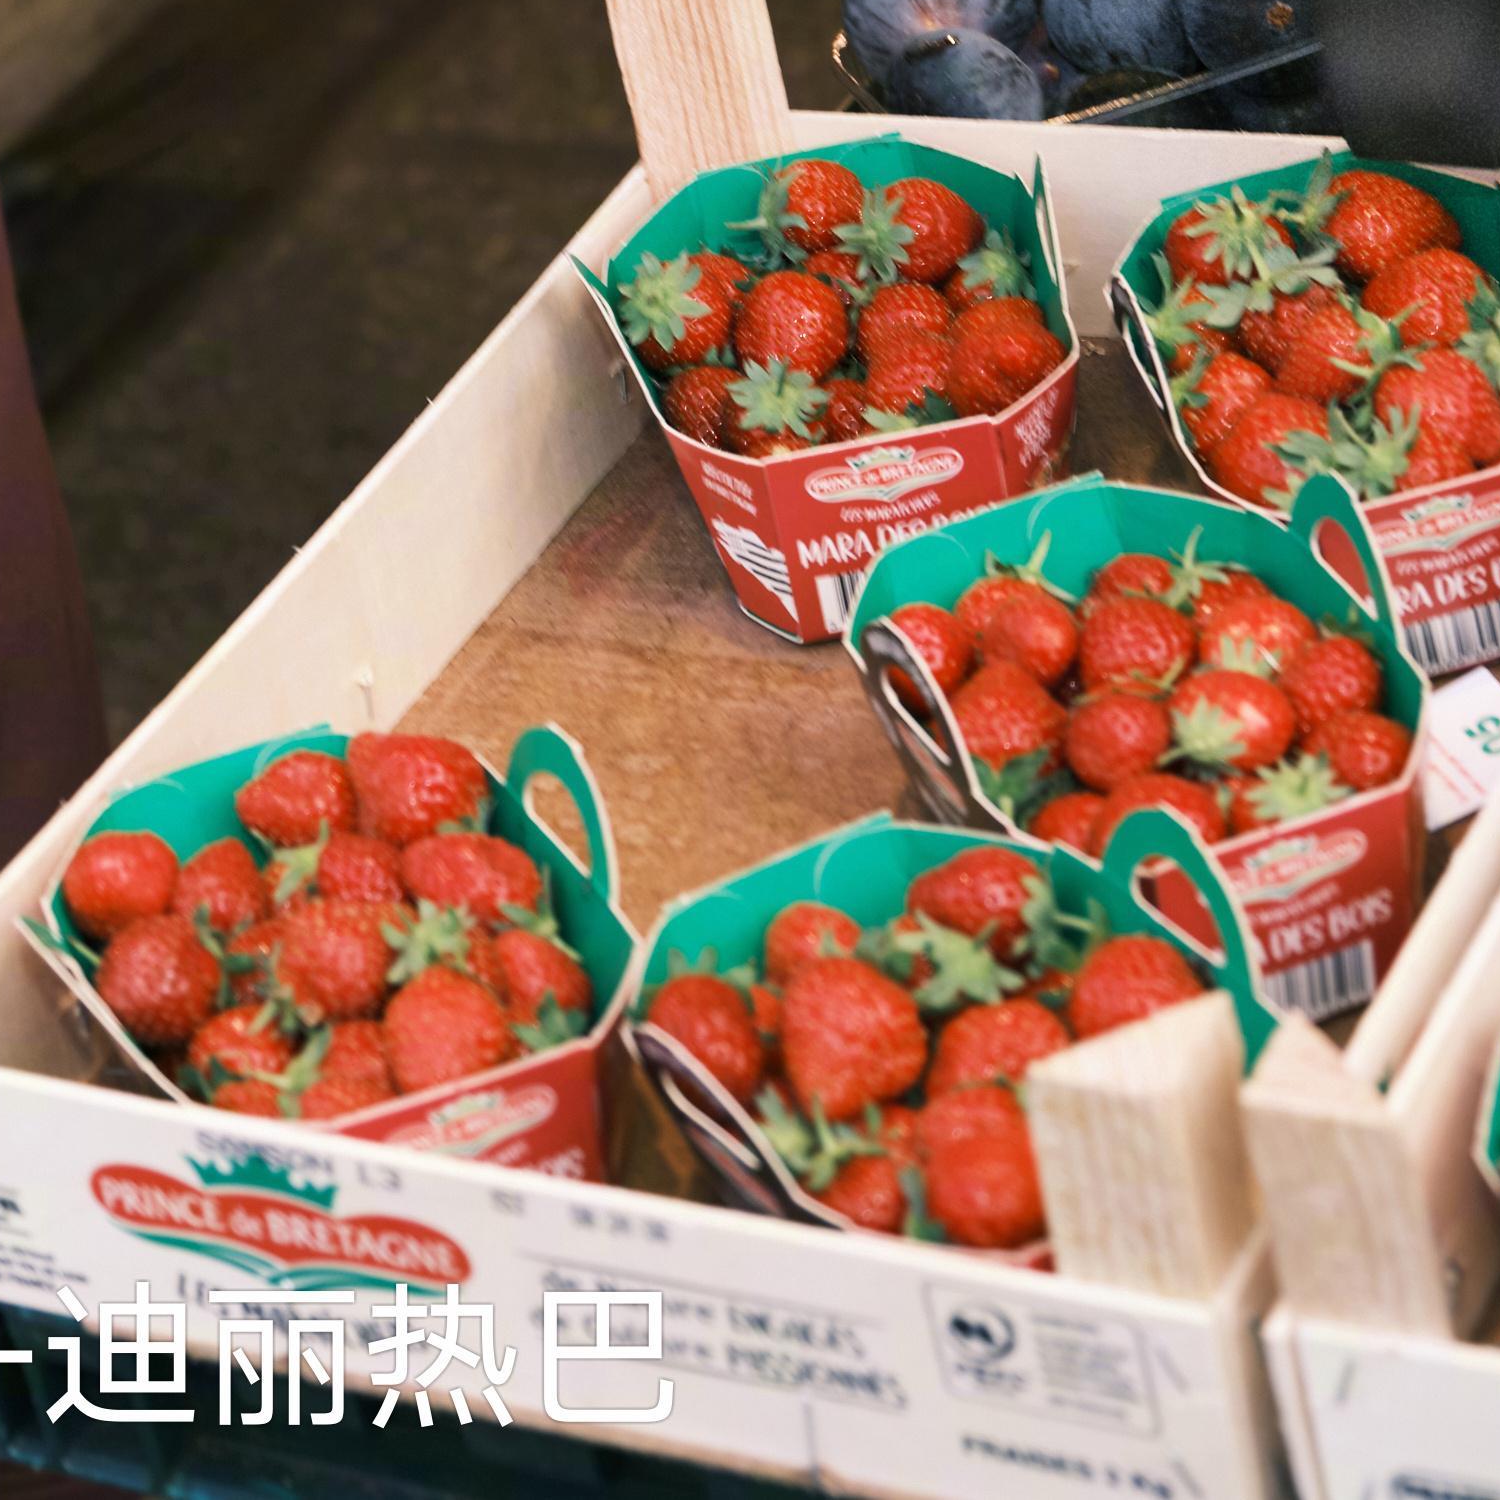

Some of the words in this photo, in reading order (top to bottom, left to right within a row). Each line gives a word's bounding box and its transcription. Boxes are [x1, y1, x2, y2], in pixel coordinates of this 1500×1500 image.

[796, 527, 875, 569] MARA
[1434, 564, 1488, 605] DES
[1327, 887, 1393, 942] BOIS
[101, 1177, 218, 1236] PRINCE
[223, 1207, 263, 1239] de
[269, 1212, 458, 1279] BRETAGNE
